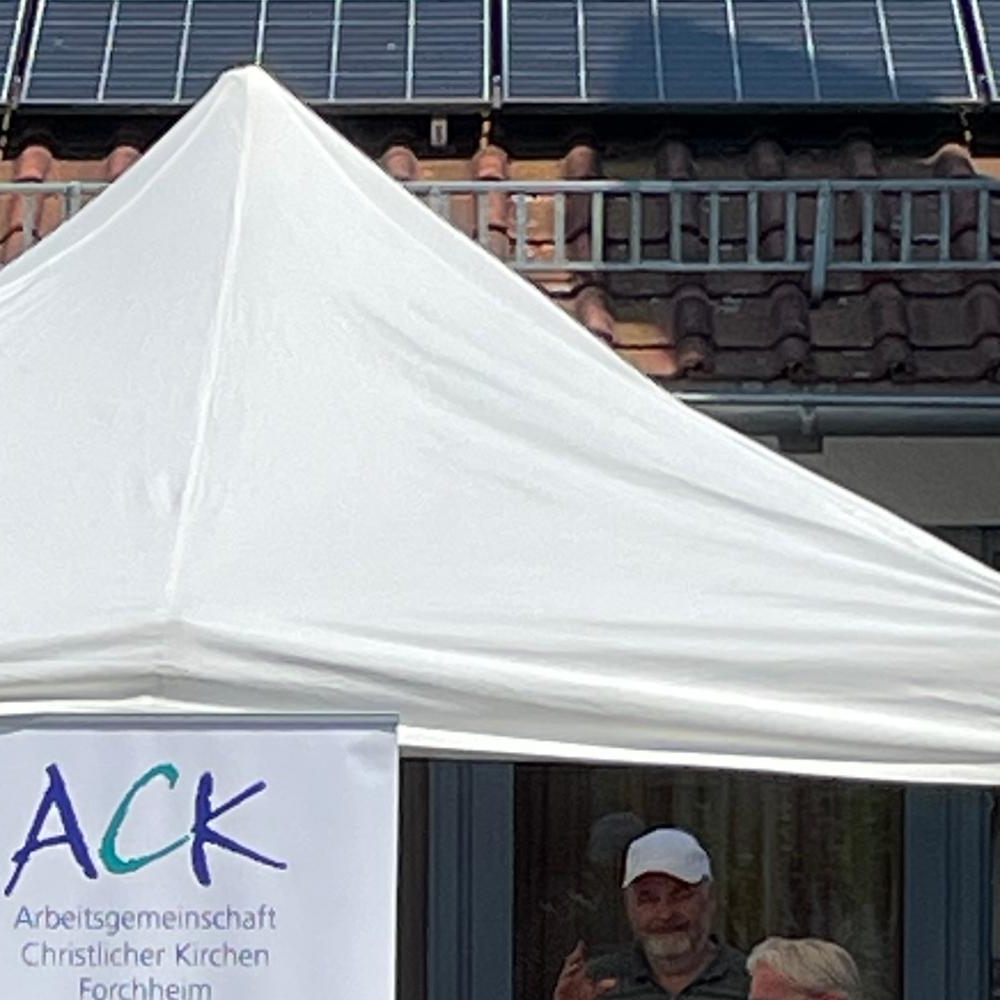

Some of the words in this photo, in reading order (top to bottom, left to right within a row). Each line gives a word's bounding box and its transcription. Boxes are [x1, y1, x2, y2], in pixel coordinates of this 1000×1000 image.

[4, 763, 287, 896] ACK
[13, 905, 276, 936] Arbeitsgemeinschaft
[21, 942, 165, 968] Christlicher
[176, 943, 269, 967] Kirchen
